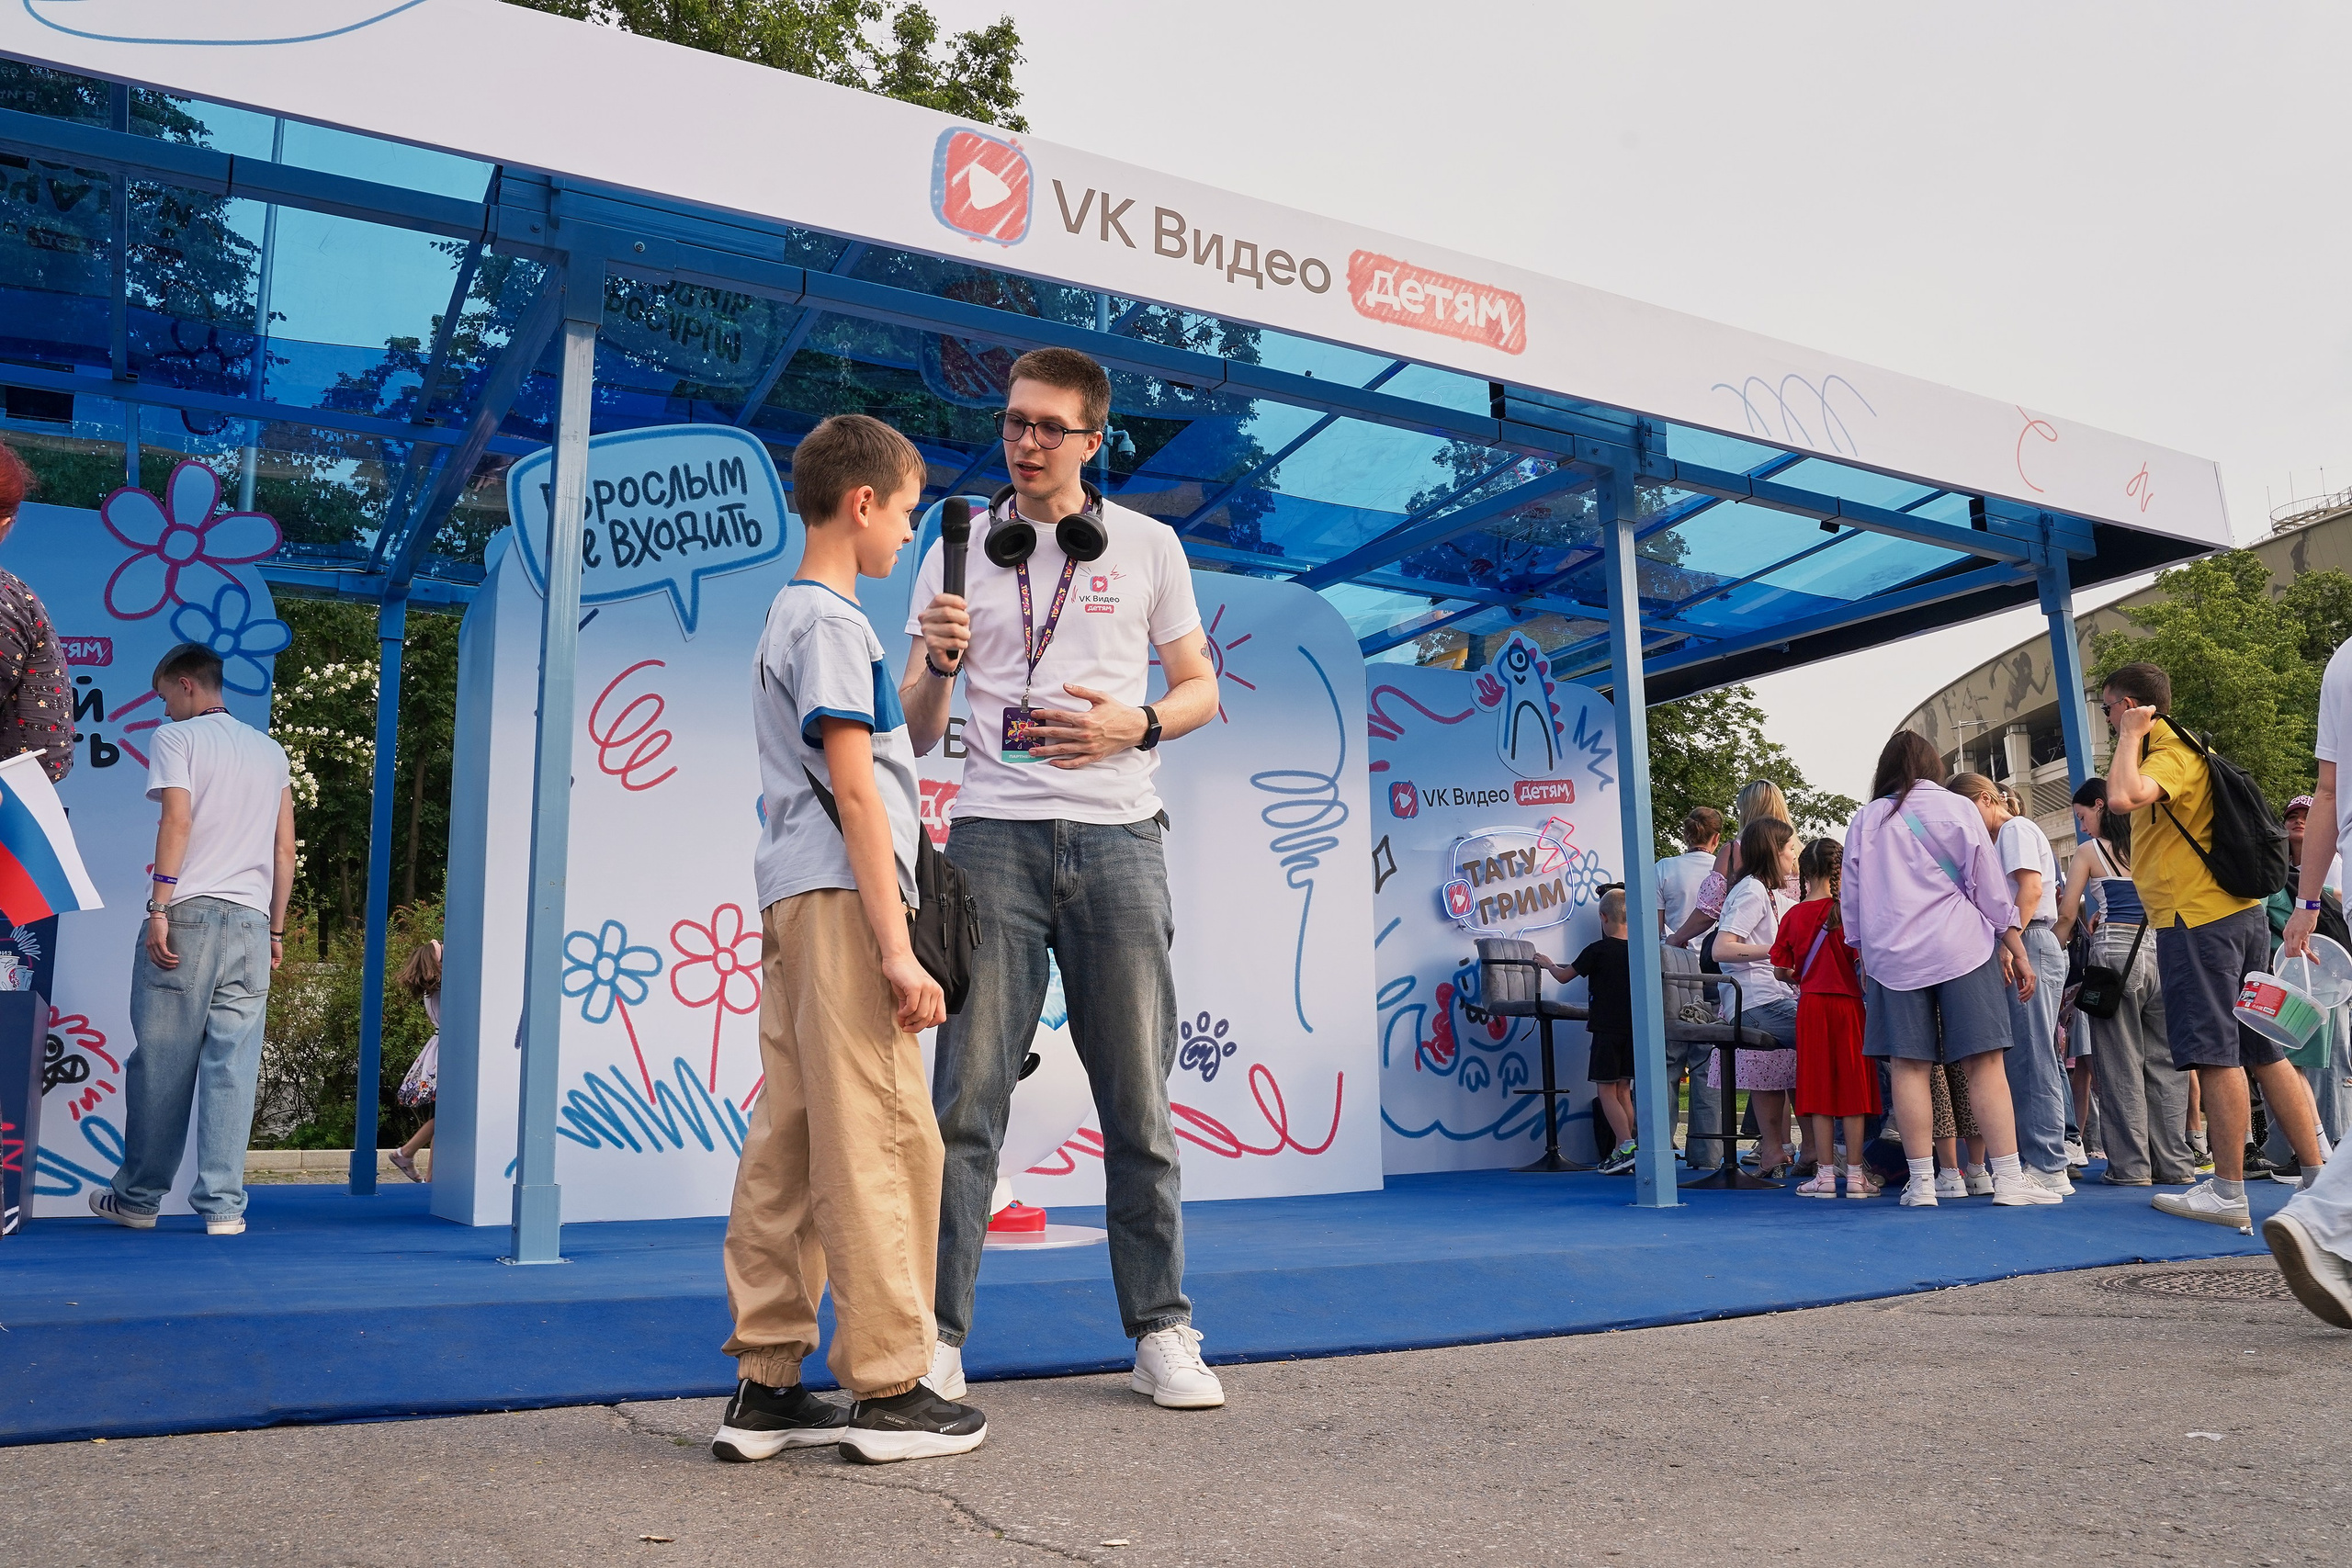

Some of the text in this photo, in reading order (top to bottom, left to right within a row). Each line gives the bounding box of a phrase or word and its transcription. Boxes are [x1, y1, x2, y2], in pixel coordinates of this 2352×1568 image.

[1052, 178, 1136, 249] VK
[1155, 206, 1331, 294] Видео
[540, 456, 748, 525] РОСЛЫМ
[608, 502, 763, 569] ВХОДИТЬ
[1422, 783, 1571, 807] VK Видео детям
[1463, 846, 1536, 887] ТАТУ
[1479, 878, 1566, 925] ГРИМ
